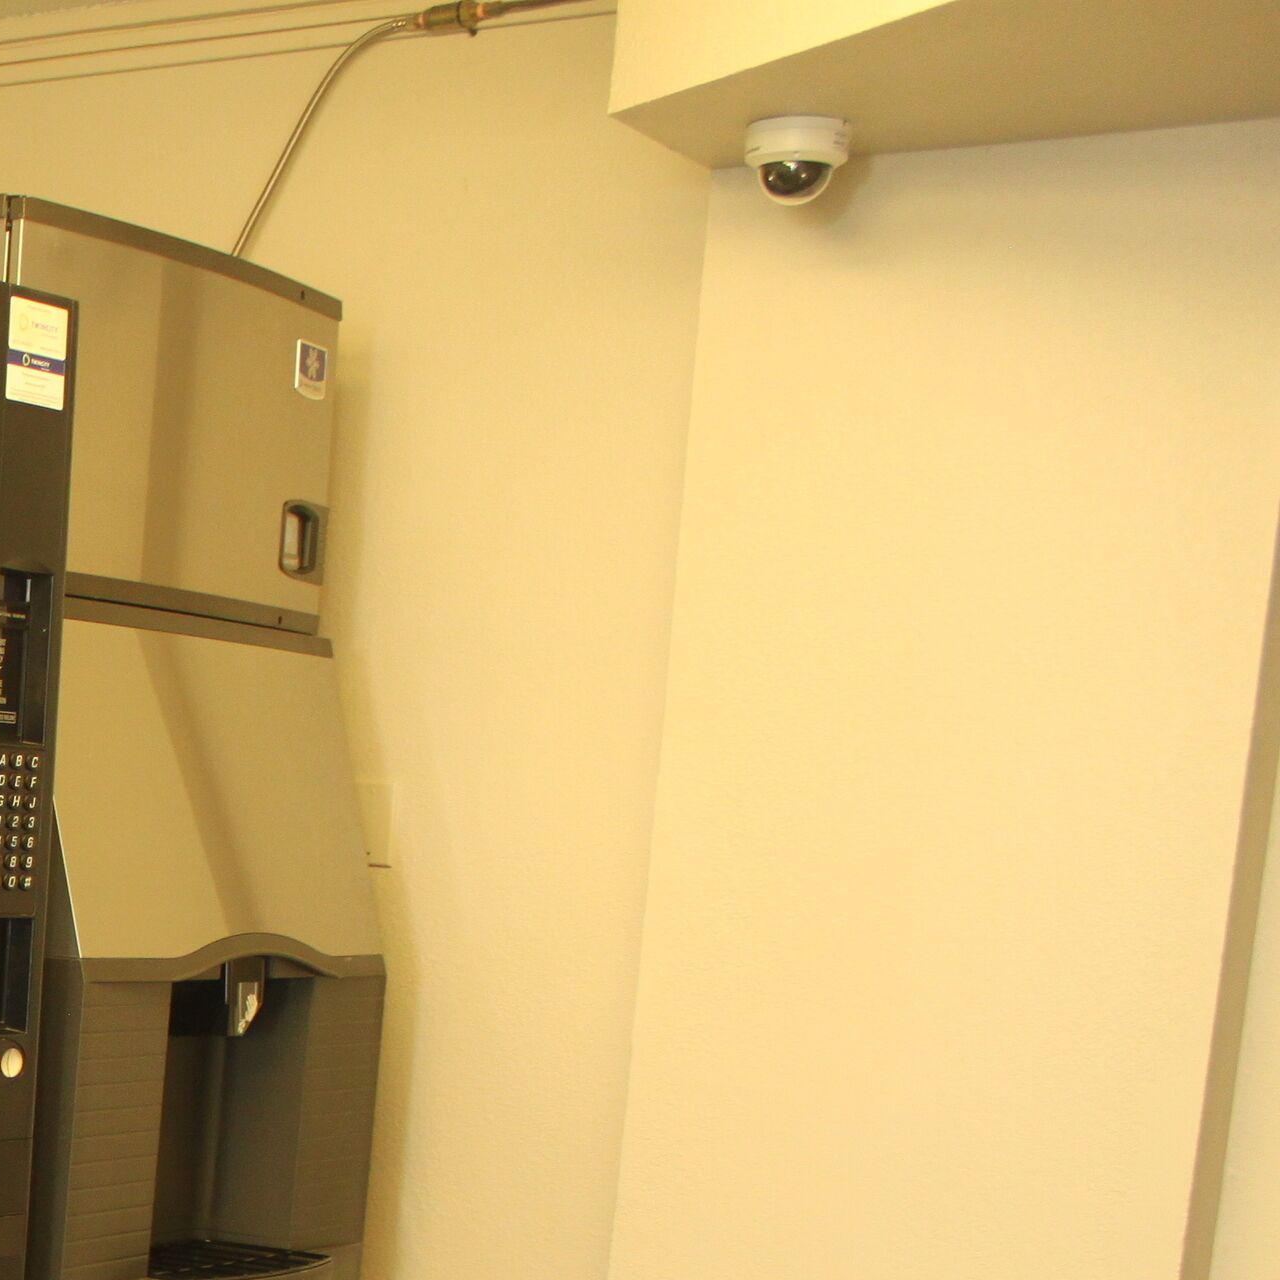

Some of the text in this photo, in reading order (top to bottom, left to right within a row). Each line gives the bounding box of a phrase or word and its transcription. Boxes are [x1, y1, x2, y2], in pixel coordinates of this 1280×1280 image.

[0, 754, 39, 768] A B C
[14, 775, 22, 787] E
[30, 776, 37, 788] F
[12, 795, 20, 807] H
[29, 797, 36, 808] J
[11, 815, 19, 828] 2
[28, 816, 35, 828] 3
[11, 835, 18, 847] 5
[26, 836, 34, 849] 6
[9, 856, 16, 868] 8
[25, 856, 33, 868] 9
